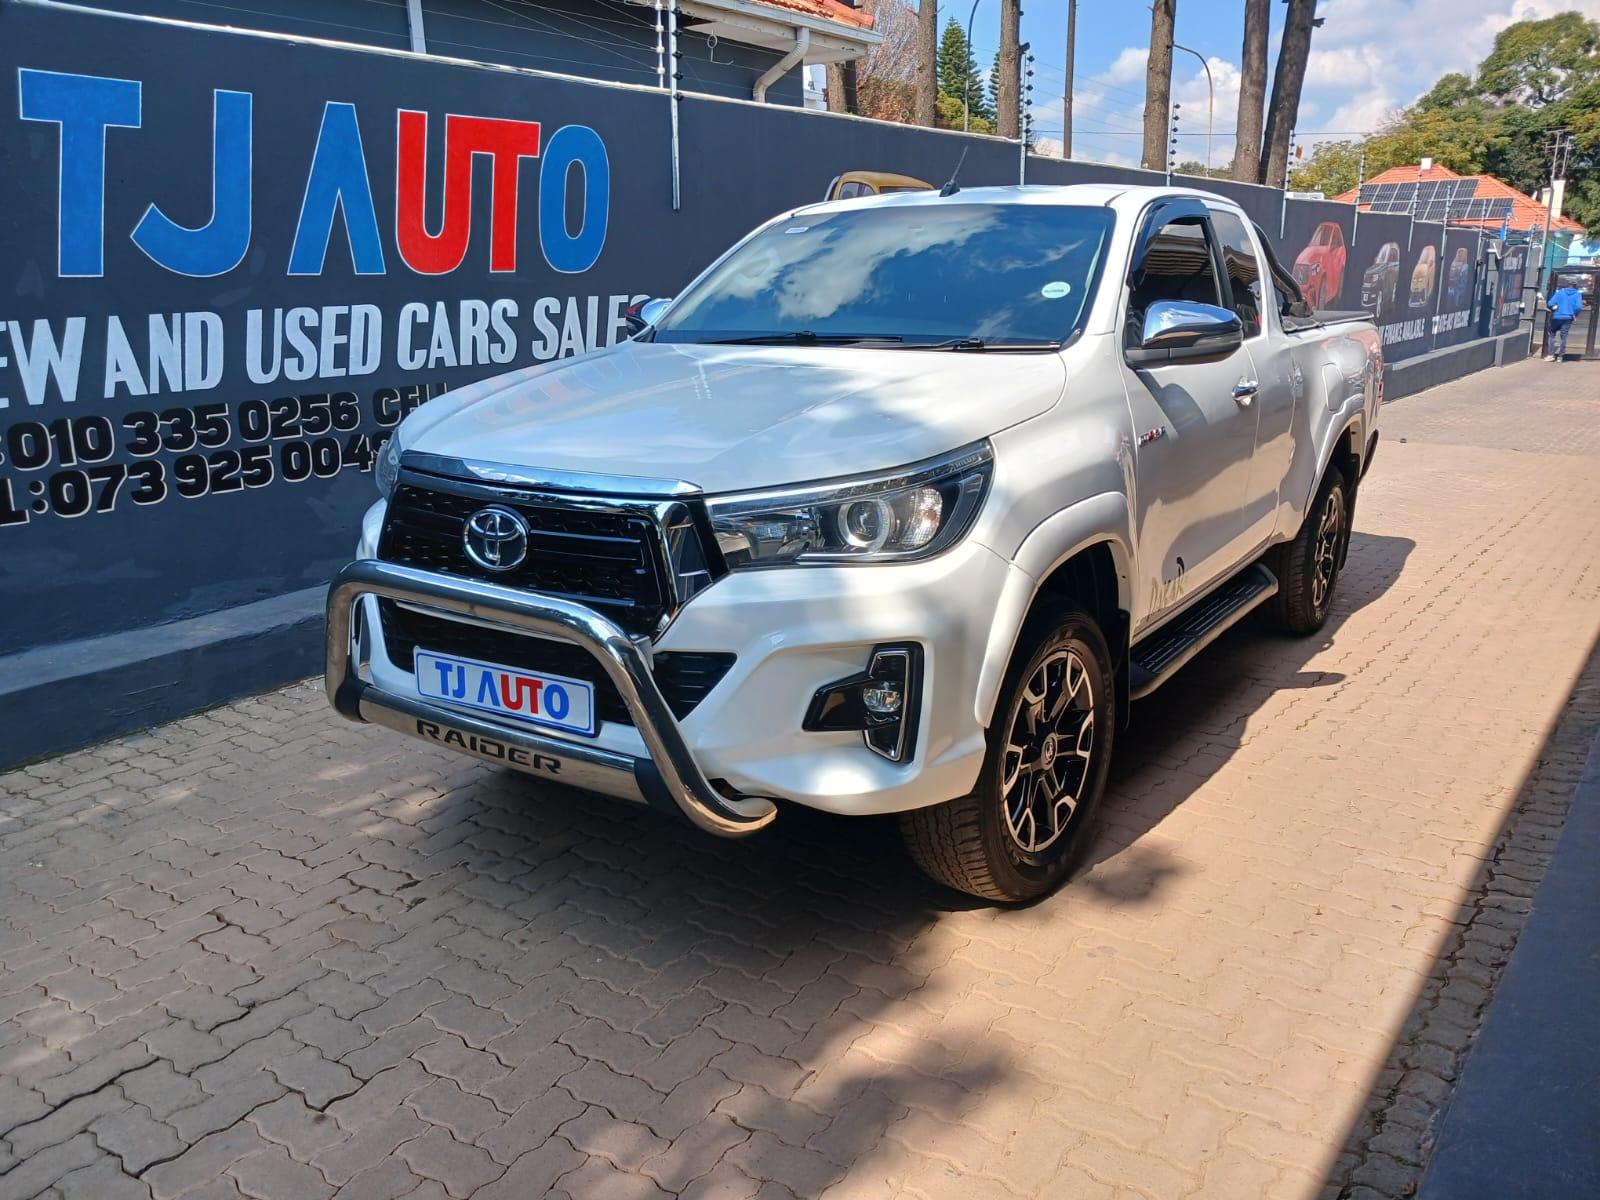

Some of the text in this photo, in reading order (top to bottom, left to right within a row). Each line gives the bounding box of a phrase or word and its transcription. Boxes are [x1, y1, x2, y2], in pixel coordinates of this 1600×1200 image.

[18, 67, 610, 278] TJ AUTO
[104, 311, 224, 399] AND
[246, 304, 382, 383] USED
[397, 297, 518, 371] CARS
[124, 403, 232, 458] 335
[238, 391, 361, 446] 0256
[372, 382, 448, 428] CE
[176, 443, 275, 499] 925
[435, 660, 570, 721] TJ AUTO
[416, 718, 562, 775] RAIDER
